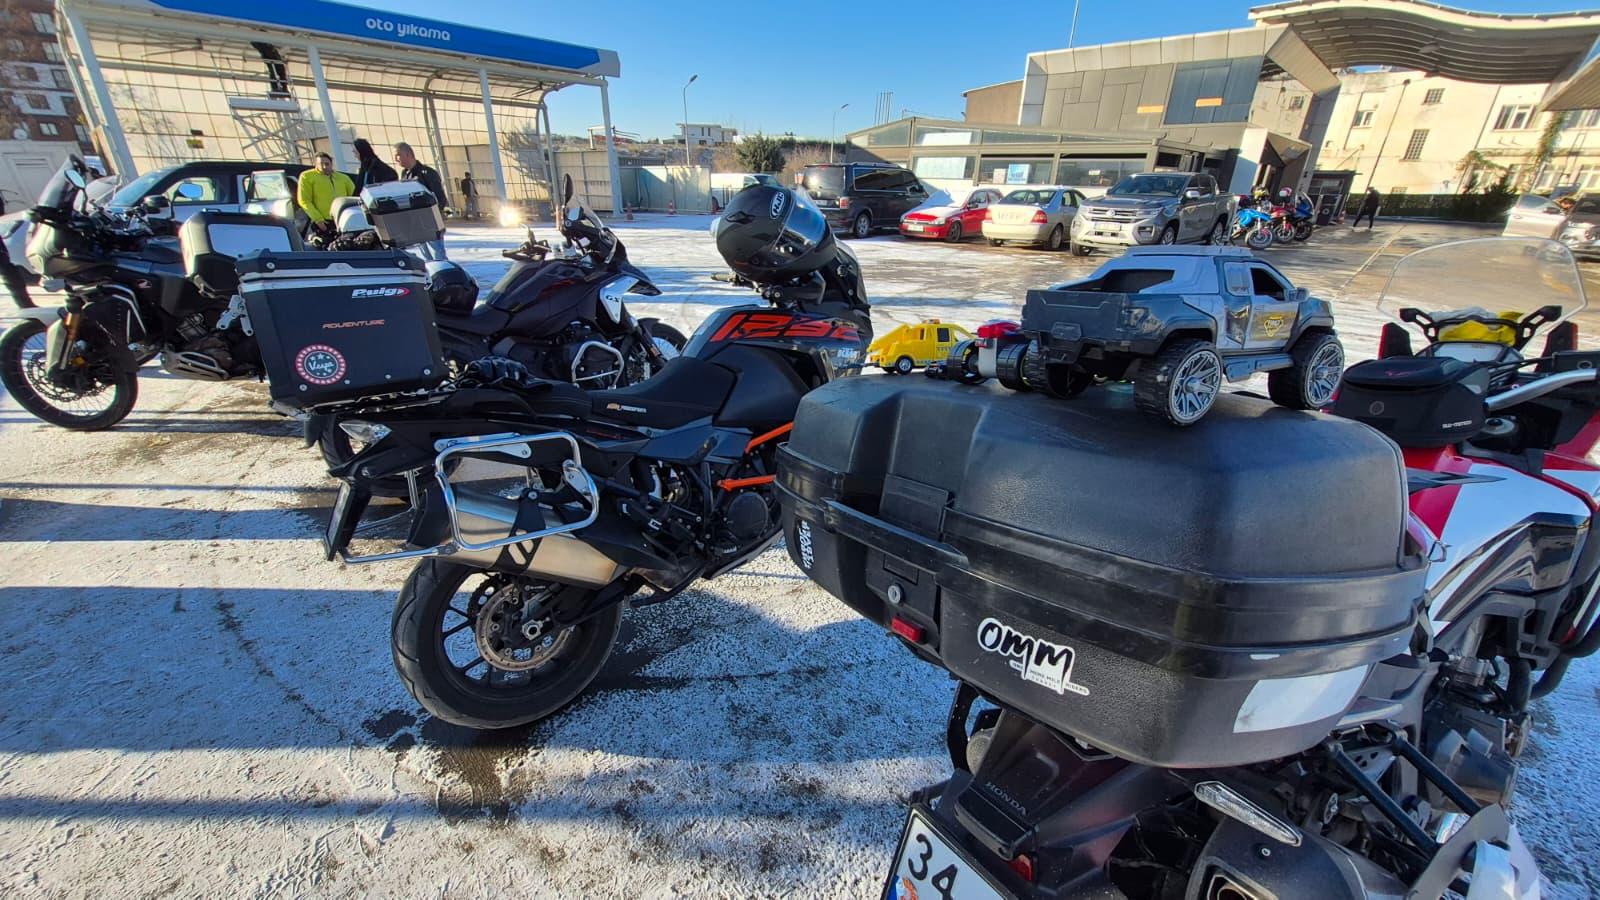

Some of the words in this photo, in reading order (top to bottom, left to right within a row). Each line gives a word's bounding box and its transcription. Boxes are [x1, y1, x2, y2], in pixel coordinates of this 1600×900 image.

[366, 18, 394, 32] oto
[397, 23, 451, 41] yıkama
[352, 287, 398, 298] Puig
[985, 781, 1027, 816] HONDA
[908, 833, 958, 900] 34
